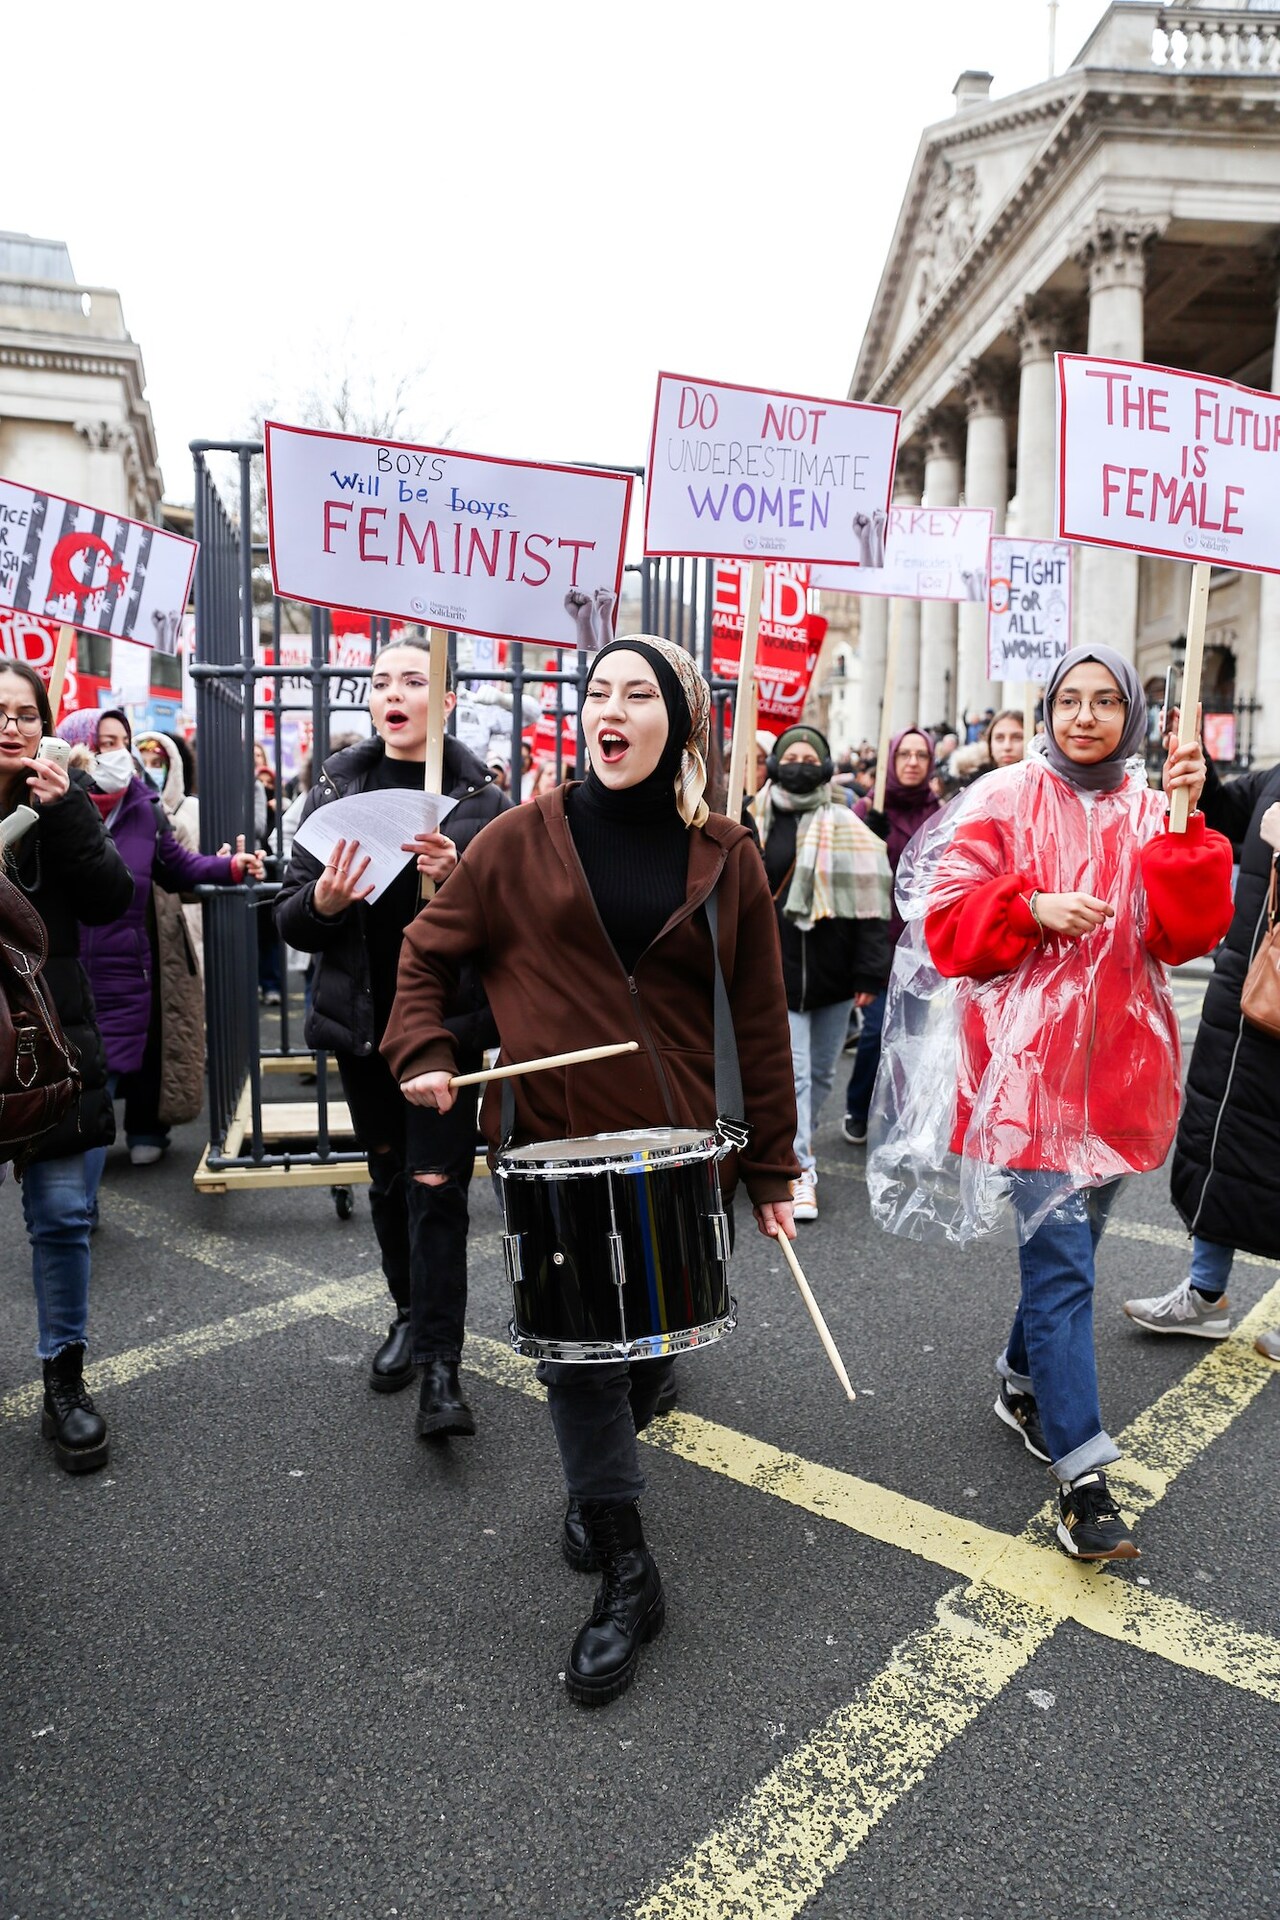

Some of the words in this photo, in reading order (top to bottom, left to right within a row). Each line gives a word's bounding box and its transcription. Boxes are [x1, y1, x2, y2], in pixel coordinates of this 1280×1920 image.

[678, 387, 718, 429] DO
[762, 403, 826, 444] NOT
[1086, 370, 1170, 433] THE
[377, 449, 445, 480] BOYS
[668, 438, 869, 490] UNDERESTIMATE
[1181, 446, 1208, 478] IS
[399, 480, 428, 502] be
[449, 488, 510, 519] boys
[687, 483, 829, 530] WOMEN
[1103, 464, 1244, 534] FEMALE
[322, 500, 595, 587] FEMINIST
[1010, 555, 1066, 585] FIGHT
[430, 607, 466, 622] Solidarity
[1008, 588, 1042, 611] FOR
[1008, 614, 1043, 635] ALL
[1002, 640, 1067, 659] WOMEN
